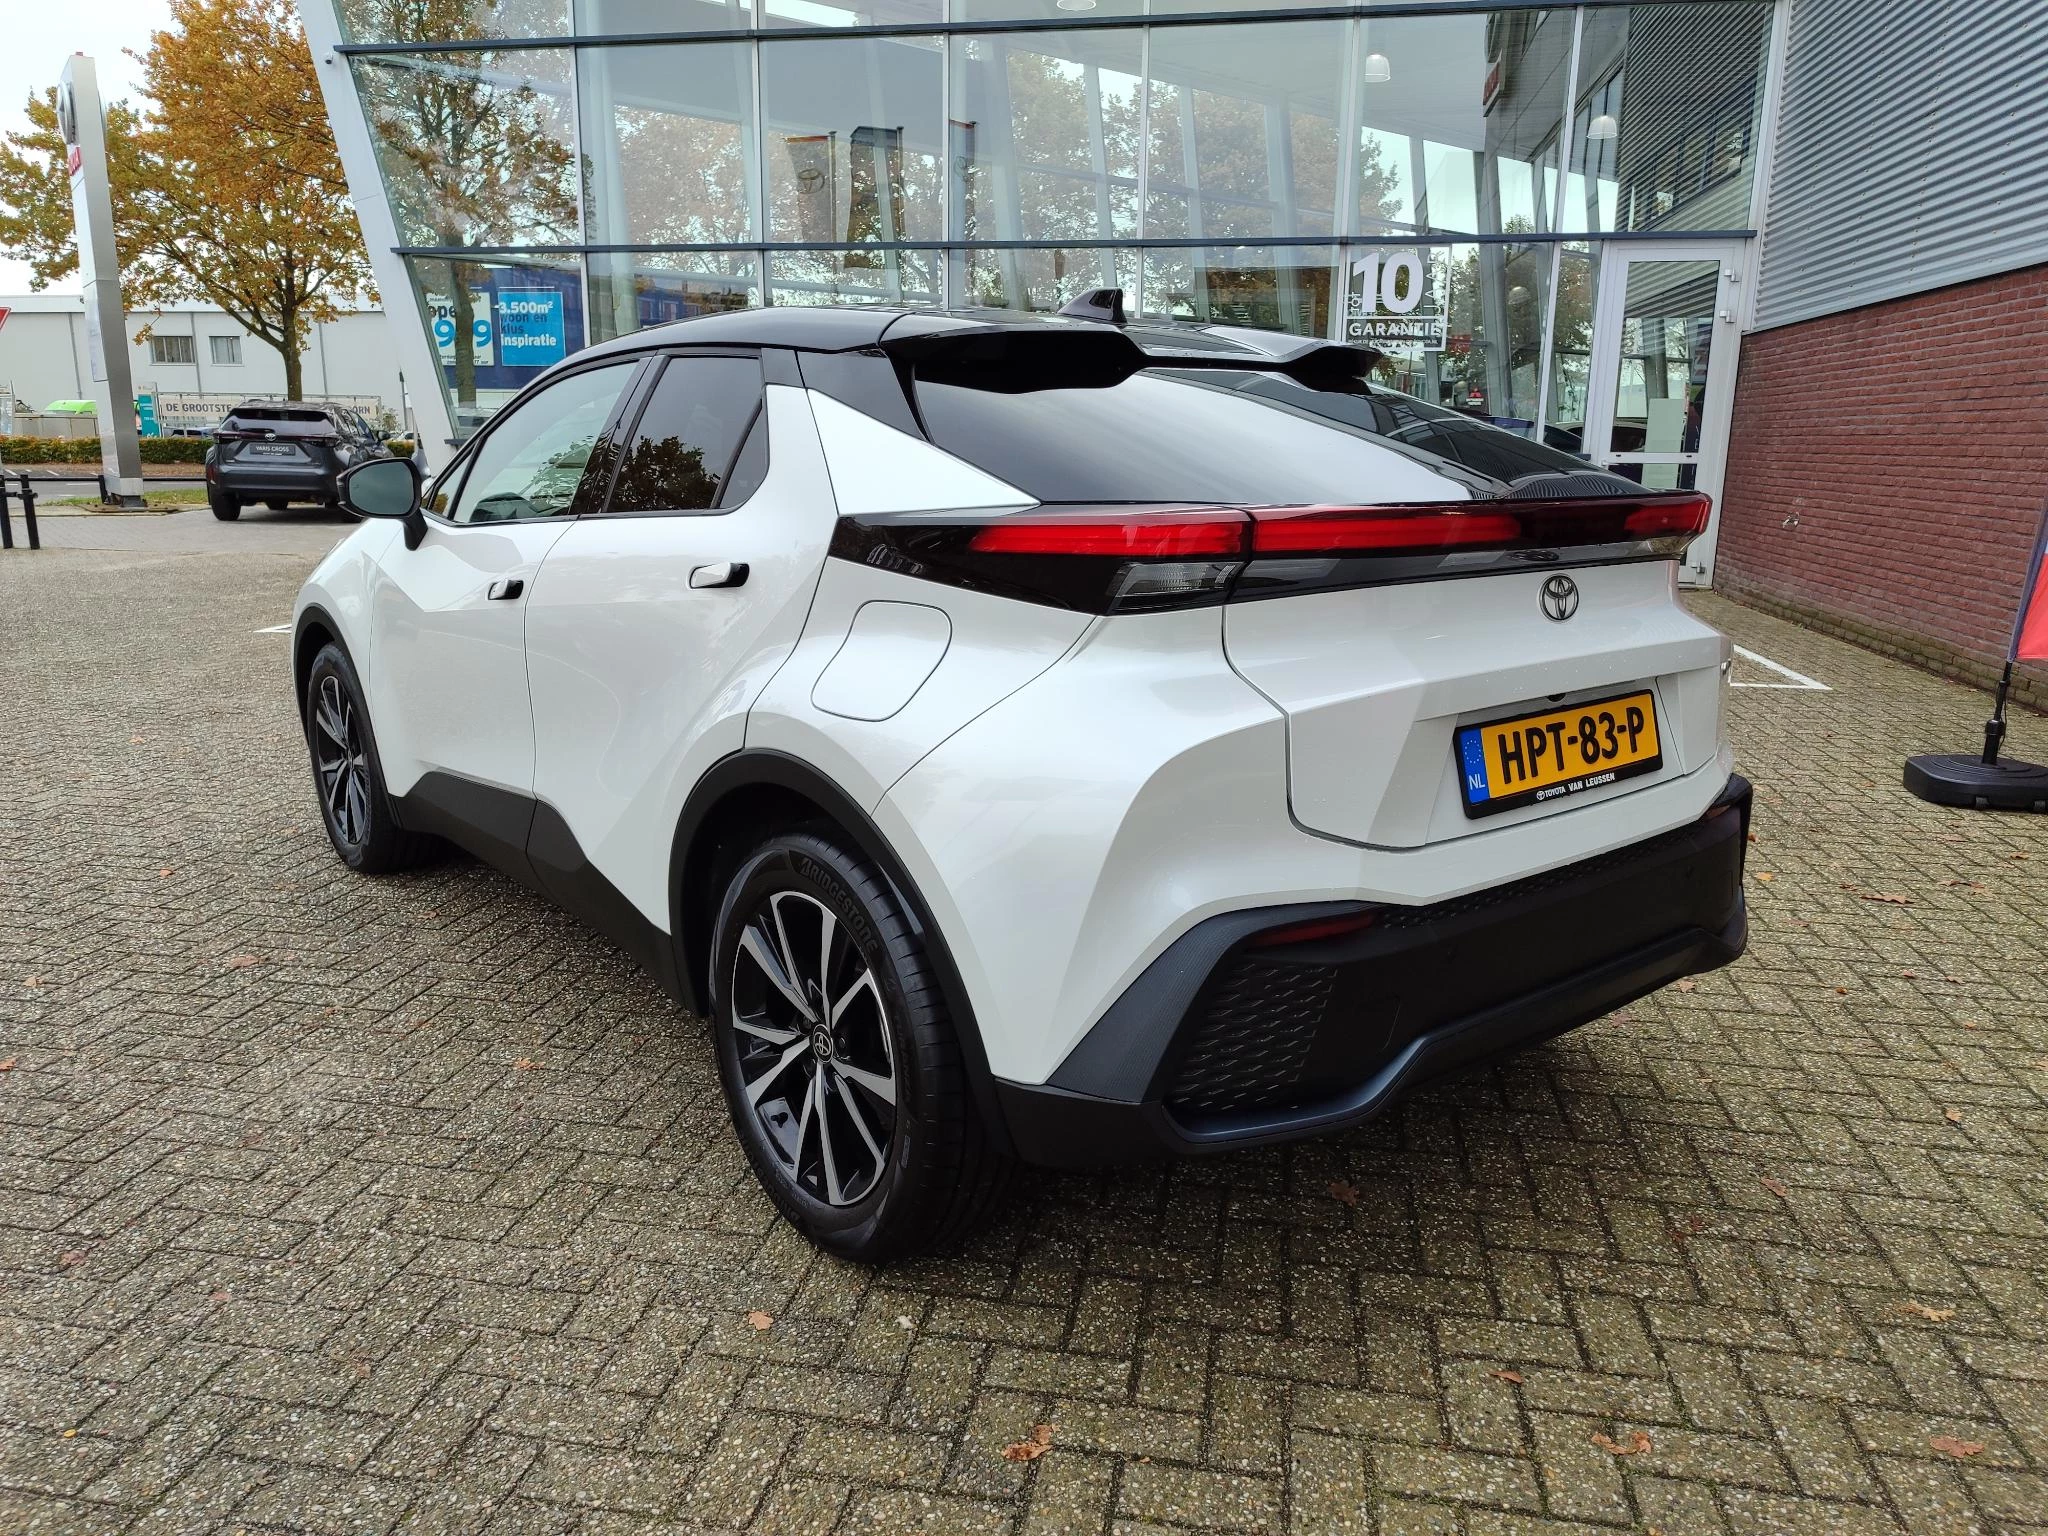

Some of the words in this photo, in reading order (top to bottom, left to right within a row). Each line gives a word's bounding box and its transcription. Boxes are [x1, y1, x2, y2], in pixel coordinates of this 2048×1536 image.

[1353, 252, 1424, 314] 10
[533, 314, 548, 323] en
[501, 322, 524, 334] klus
[1348, 322, 1442, 337] GARANTIE
[501, 333, 557, 349] inspiratie
[166, 403, 180, 412] DE
[182, 403, 232, 413] GROOTSTE
[1497, 706, 1645, 785] HPT-83-P
[1468, 773, 1486, 790] NL
[1544, 785, 1566, 798] TOYOTA
[1568, 780, 1584, 792] VAN
[1585, 772, 1616, 788] LEUSSEN
[799, 856, 879, 951] BRIDGESTONE
